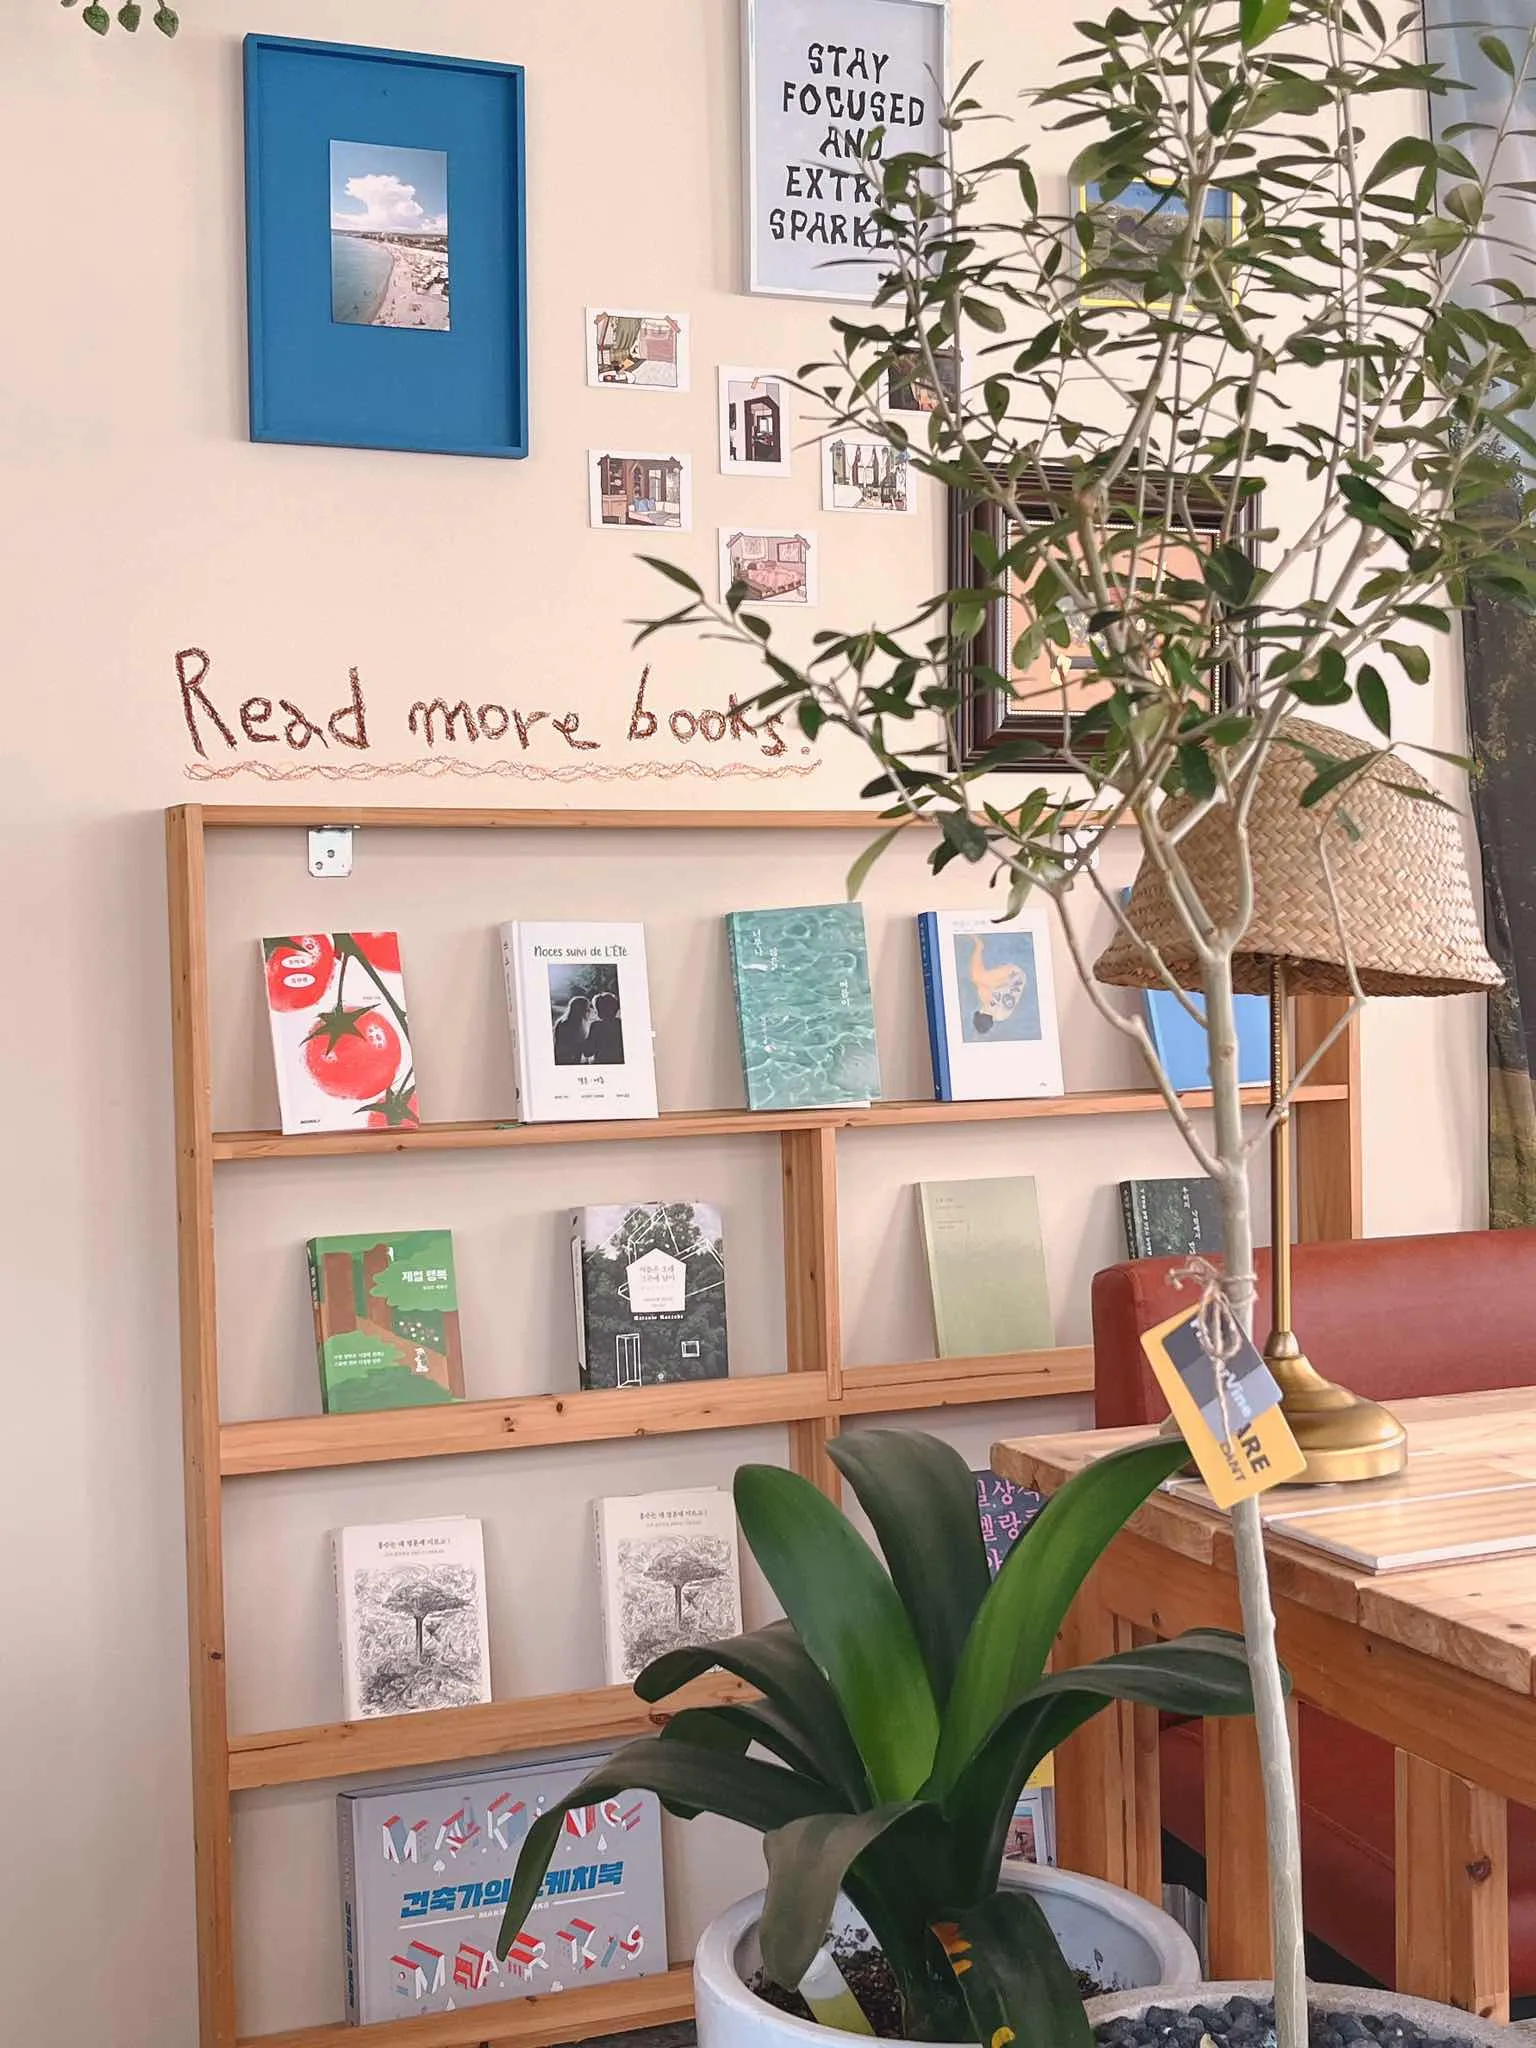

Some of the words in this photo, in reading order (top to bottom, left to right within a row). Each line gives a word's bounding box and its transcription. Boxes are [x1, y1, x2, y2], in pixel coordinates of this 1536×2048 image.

[807, 43, 889, 84] STAY
[782, 81, 926, 127] FOCUSED
[786, 165, 898, 209] EXTR
[769, 208, 903, 250] SPARKL
[174, 647, 370, 759] Read
[409, 698, 602, 749] more
[590, 945, 603, 957] de
[400, 1877, 512, 1919] 건축가의
[536, 1861, 624, 1899] 케치북
